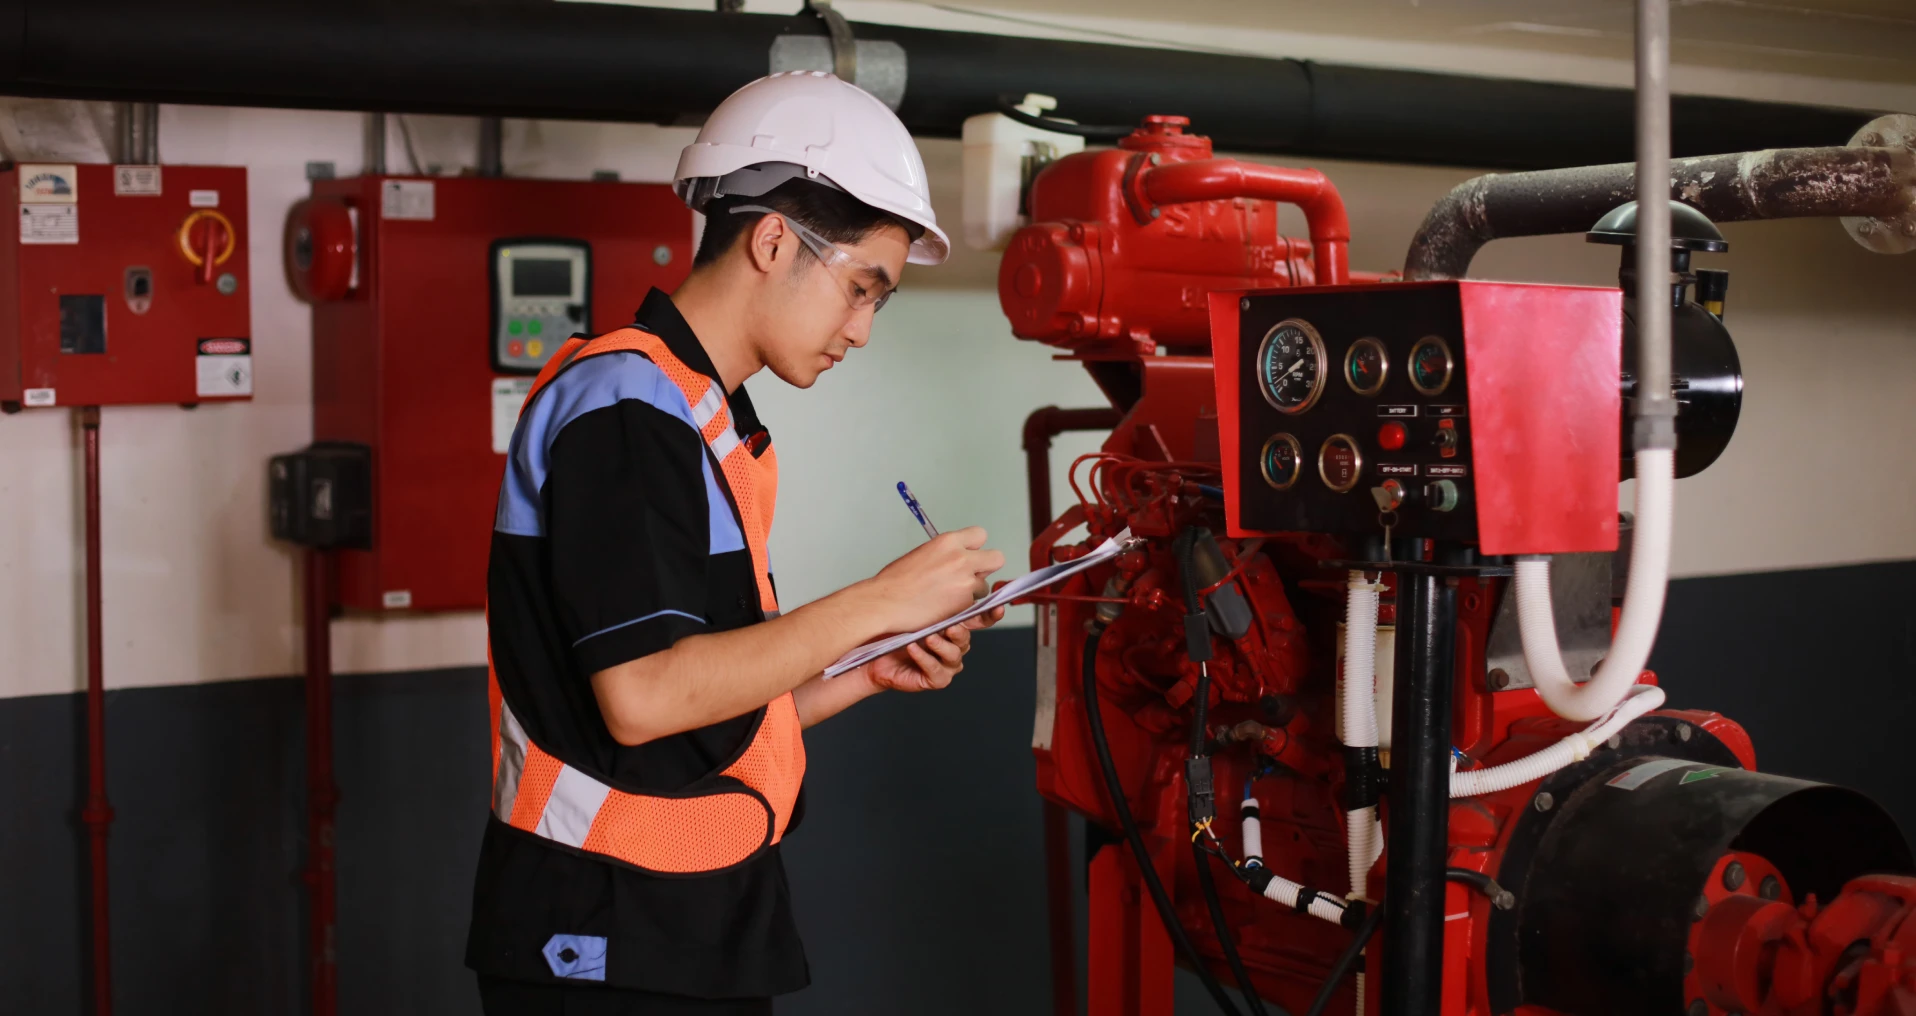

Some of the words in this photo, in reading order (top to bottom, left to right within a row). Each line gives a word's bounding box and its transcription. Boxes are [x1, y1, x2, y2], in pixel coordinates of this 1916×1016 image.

[1294, 336, 1304, 345] 15
[1281, 345, 1290, 354] 10
[1278, 362, 1284, 370] 5
[1282, 379, 1288, 387] 0
